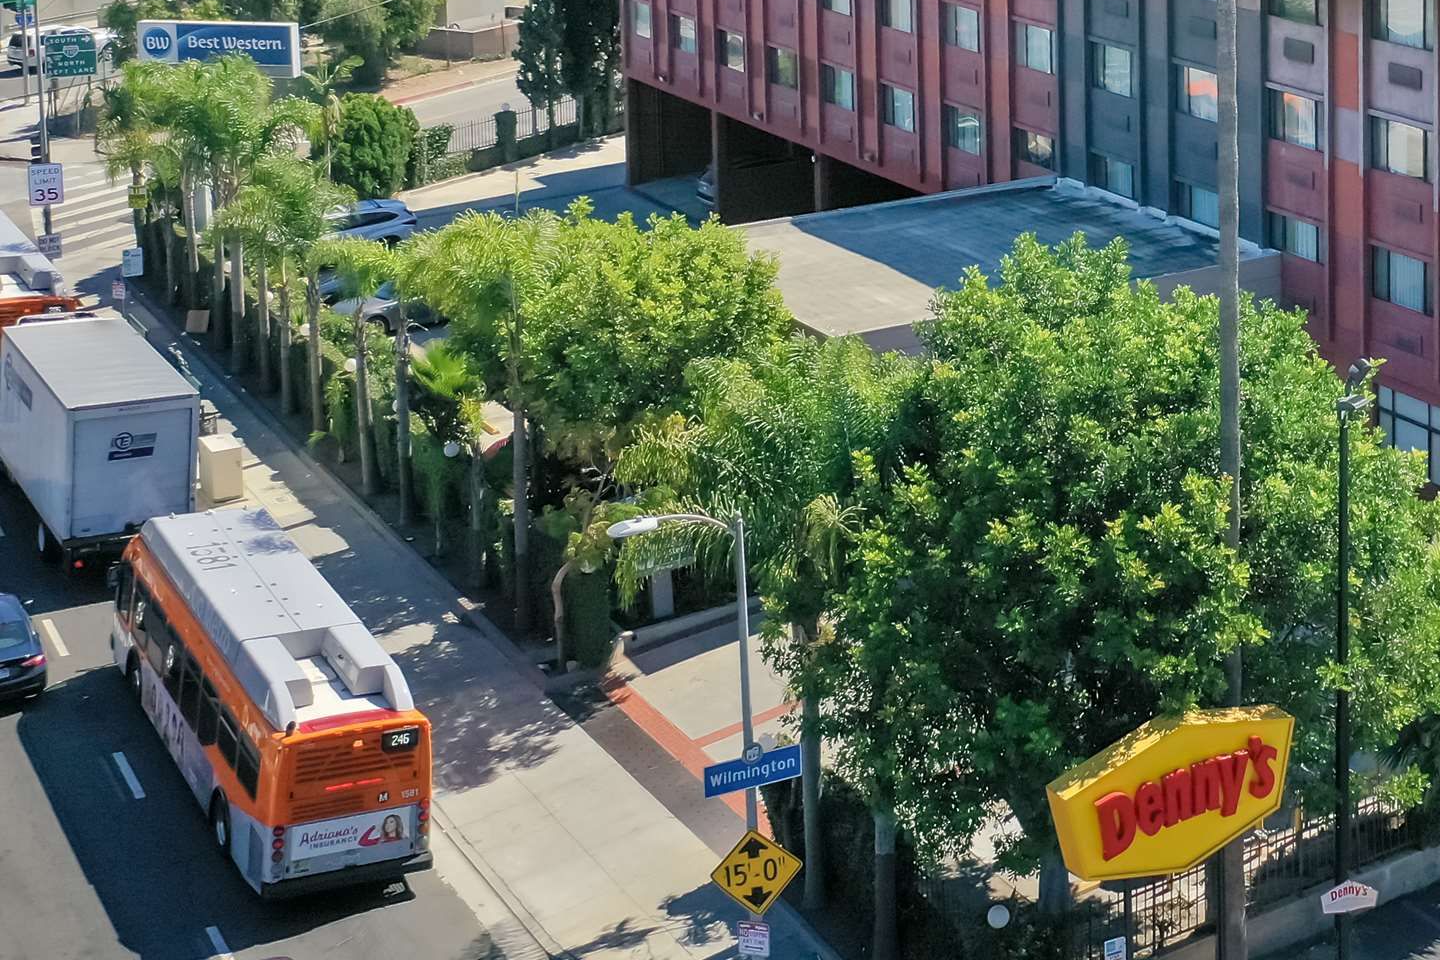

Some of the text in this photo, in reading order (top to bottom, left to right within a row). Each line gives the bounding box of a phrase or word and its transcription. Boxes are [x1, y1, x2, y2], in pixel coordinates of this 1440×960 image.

[146, 36, 169, 50] BW
[187, 35, 282, 50] Best Western
[31, 167, 60, 175] SPEED
[34, 177, 57, 185] LIMIT
[35, 187, 59, 202] 35
[186, 542, 238, 571] 1581
[391, 733, 410, 746] 246
[710, 758, 795, 787] Wilmington
[401, 788, 419, 798] 1581
[1094, 735, 1278, 862] Denny's
[300, 826, 359, 847] Adriana's
[309, 836, 358, 849] INSURANCE
[1330, 885, 1369, 901] Denny's
